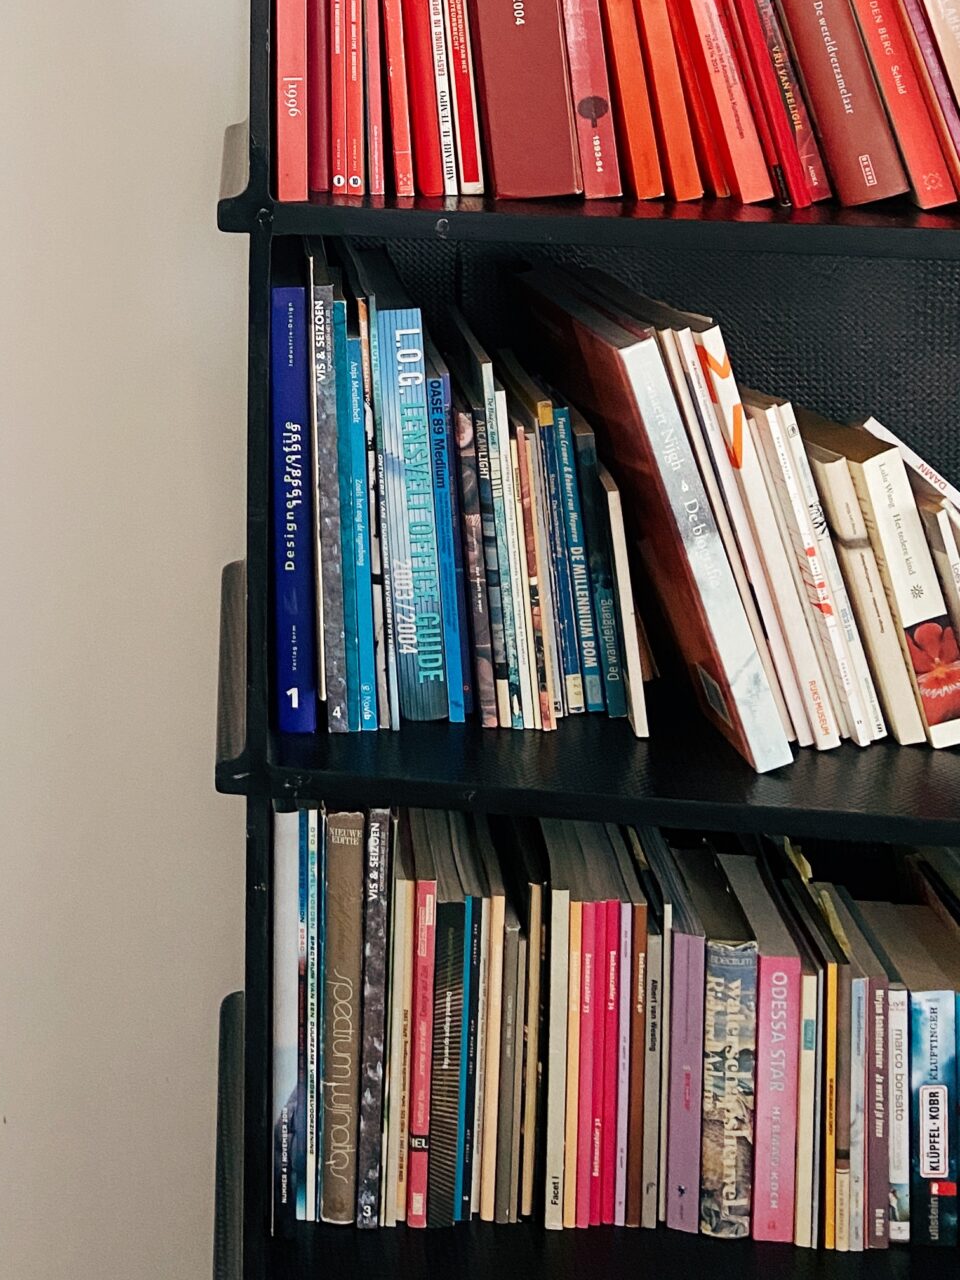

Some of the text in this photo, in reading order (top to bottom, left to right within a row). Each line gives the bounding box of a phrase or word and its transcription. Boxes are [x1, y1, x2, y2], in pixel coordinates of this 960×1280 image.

[868, 0, 885, 24] DEN
[878, 27, 895, 56] BERG
[432, 31, 446, 77] EASY-LIVING
[457, 44, 466, 60] VAN
[460, 60, 468, 74] HET
[771, 45, 785, 68] VRIJ
[812, 0, 856, 115] De wereldverzamelaar
[284, 83, 300, 117] 1996
[777, 70, 792, 89] VAN
[890, 64, 908, 95] Schuld
[783, 91, 804, 132] RELIGIE
[439, 90, 455, 182] ABITARE TEMPO
[806, 164, 820, 187] ASOKA
[314, 299, 327, 382] VIS & SEIZOEN
[349, 361, 362, 424] Anja Meulenbelt
[429, 379, 447, 489] OASE 89 Medium
[662, 429, 684, 472] Nijgh
[290, 422, 303, 506] 1998/1999
[377, 453, 386, 496] ONTWERP
[557, 416, 569, 439] Yvette
[567, 497, 576, 511] van
[917, 462, 948, 491] DAMN
[282, 421, 297, 571] Designer Profile
[356, 498, 365, 509] het
[379, 499, 387, 519] VAN
[394, 327, 445, 685] L.O.G. LENSVELT OFFICE GUIDE
[683, 497, 702, 523] De
[884, 483, 896, 509] Wang
[381, 522, 390, 570] DUURZAME
[892, 513, 917, 576] Het kind
[569, 545, 599, 668] DE MILLENNIUM BOM
[600, 599, 620, 681] De wandelgang
[284, 686, 299, 708] 1
[332, 706, 341, 718] 4
[362, 695, 374, 720] Novib
[815, 701, 831, 737] MUSEUM
[329, 827, 362, 837] NIEUWE
[331, 835, 359, 845] EDITIE
[368, 822, 381, 901] VIS & SEIZOEN
[650, 979, 659, 1004] Albert
[874, 989, 885, 1014] Mirjam
[769, 971, 788, 1092] ODESSA STAR
[928, 1007, 939, 1081] KLUFTINGER
[874, 1083, 885, 1101] werk
[894, 1028, 906, 1122] marco borsato
[281, 1124, 289, 1163] NOVEMBER
[926, 1091, 940, 1172] KLÜPFEL KOBR
[769, 1105, 781, 1209] HERMAN KOCH
[362, 1205, 372, 1217] 3
[550, 1181, 560, 1206] Facet
[928, 1197, 939, 1241] ullstein
